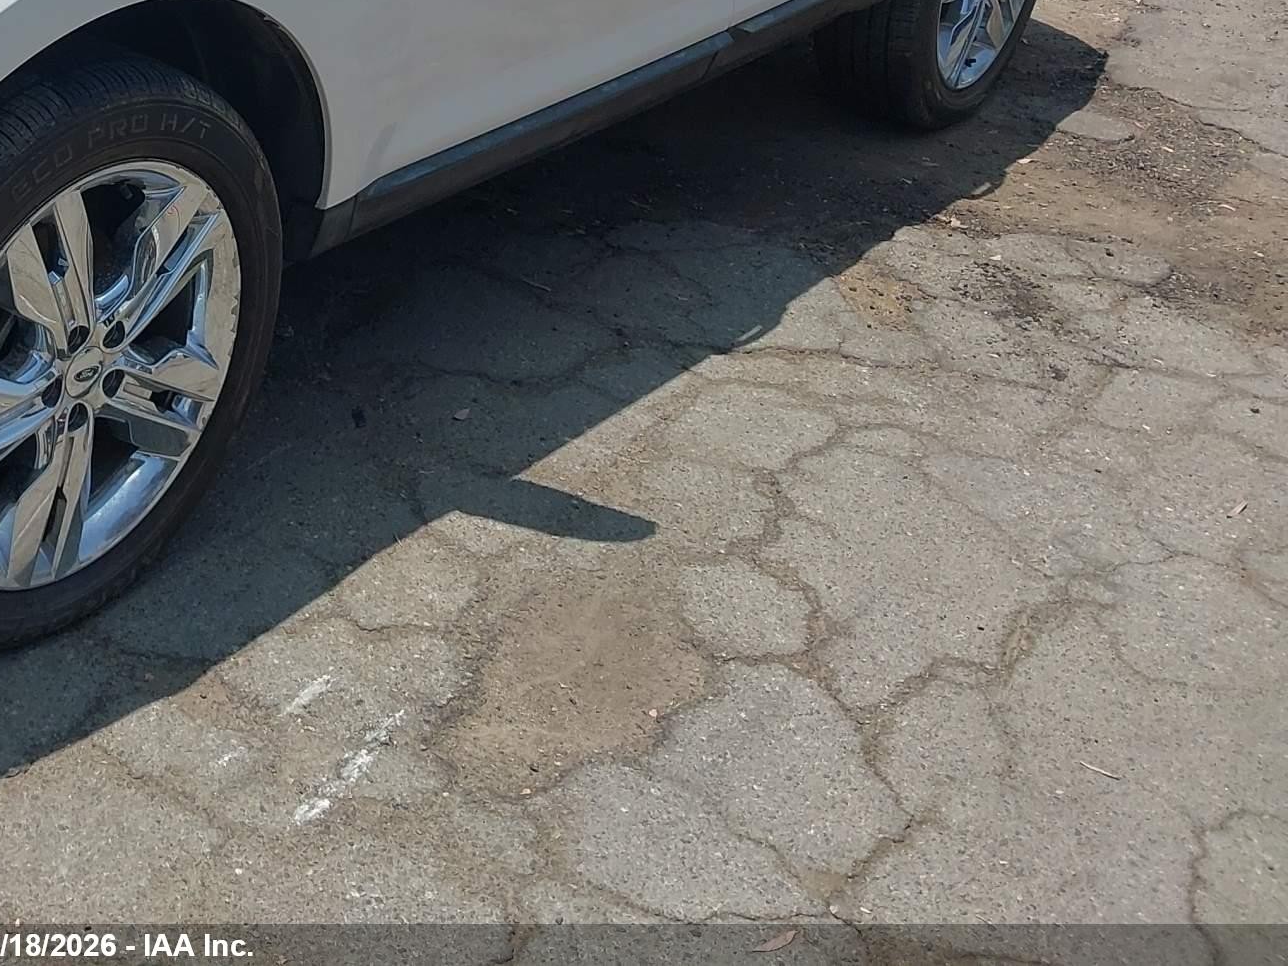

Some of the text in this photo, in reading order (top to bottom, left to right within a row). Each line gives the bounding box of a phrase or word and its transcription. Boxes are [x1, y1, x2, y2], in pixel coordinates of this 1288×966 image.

[11, 113, 211, 203] ECO PRO H/T
